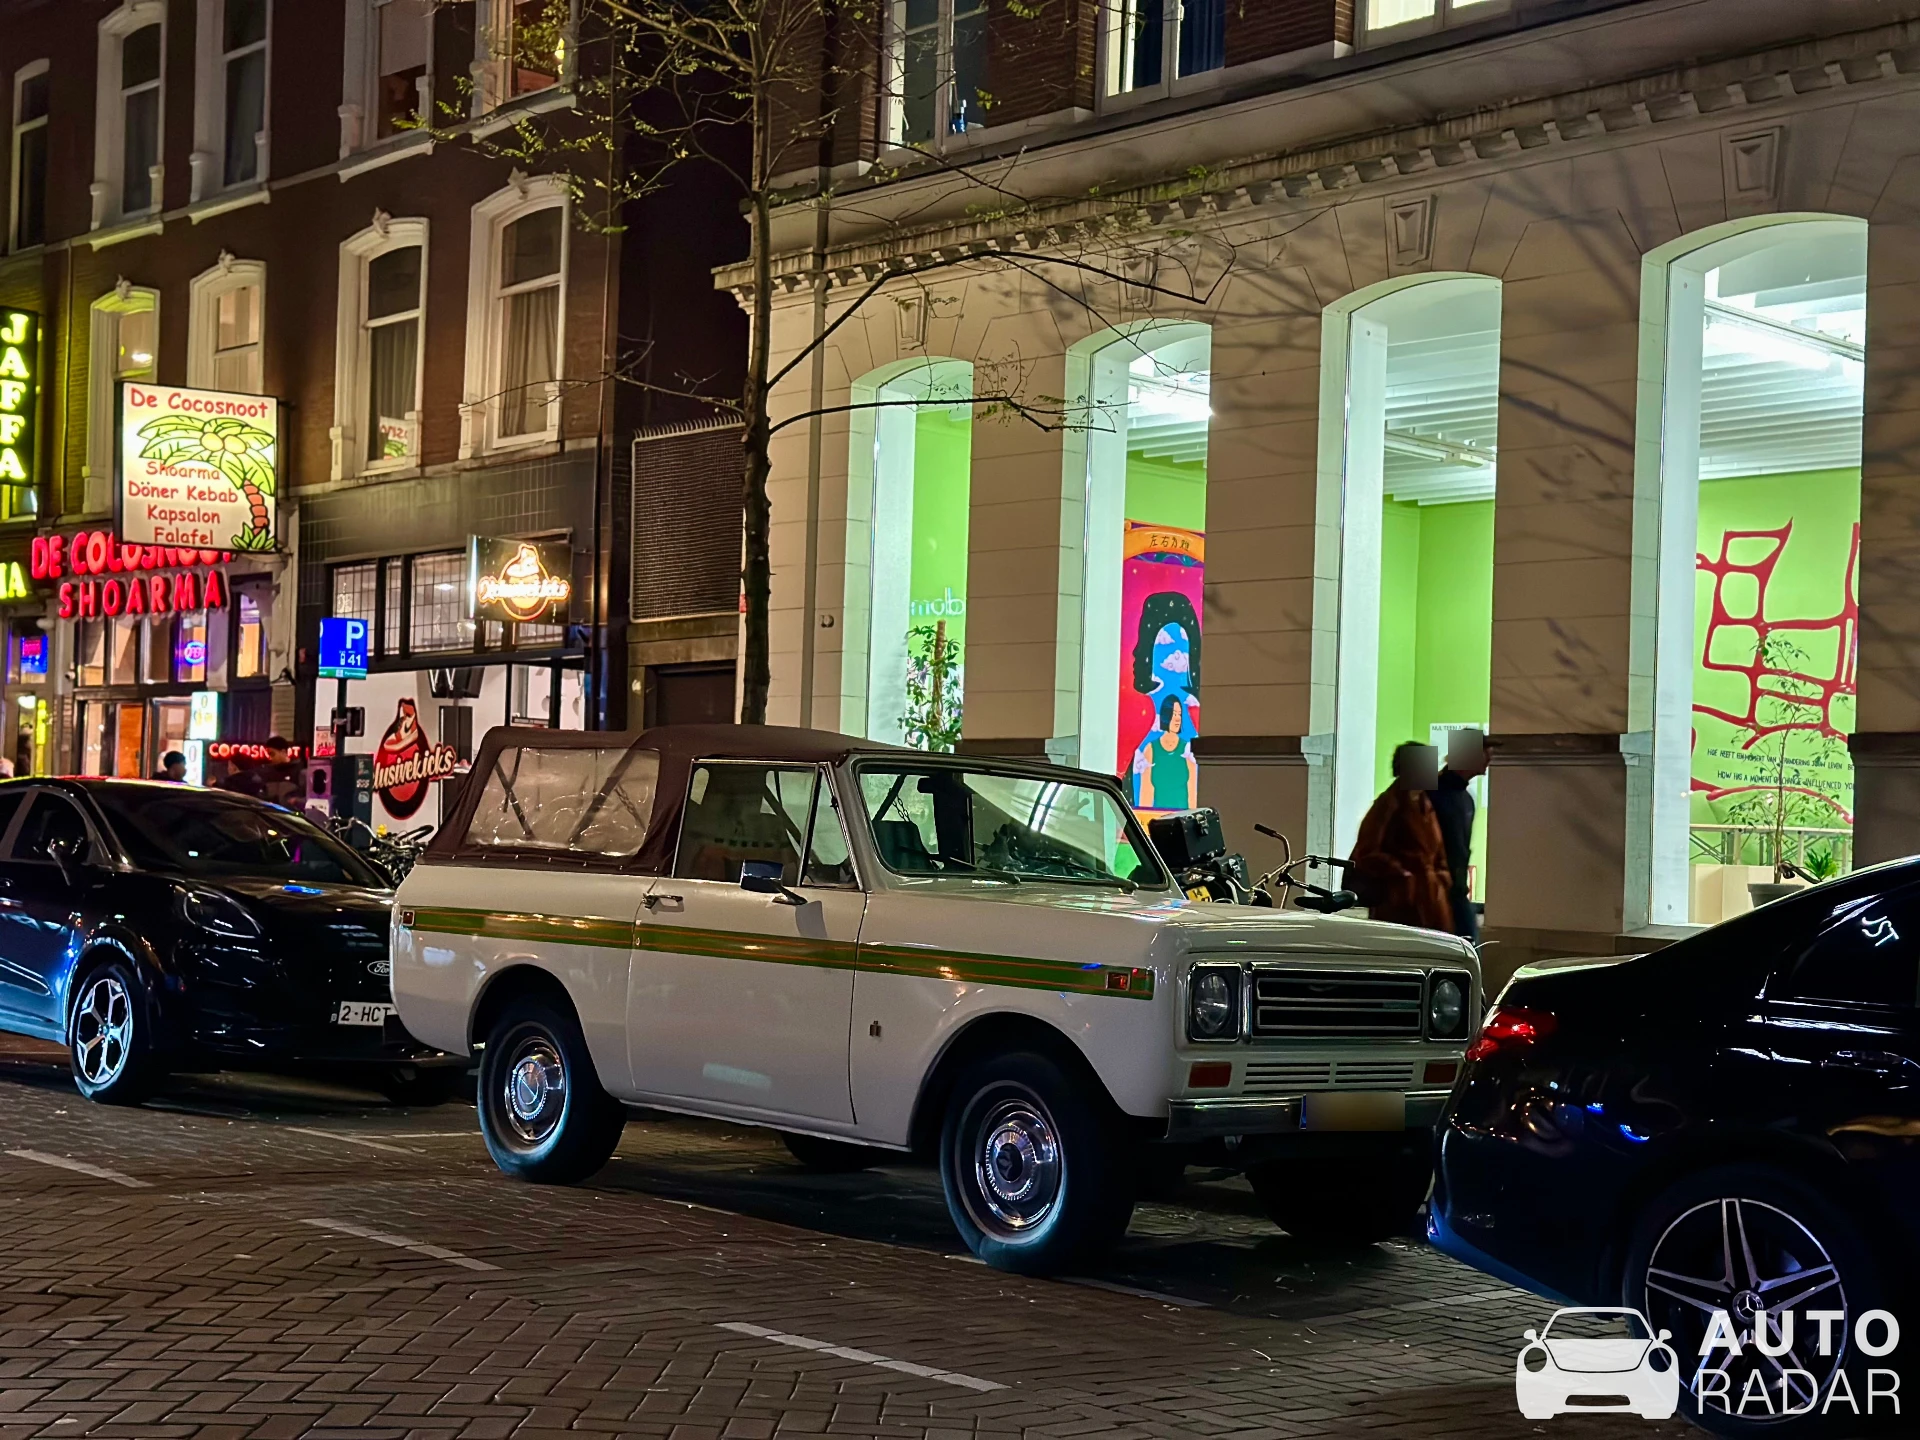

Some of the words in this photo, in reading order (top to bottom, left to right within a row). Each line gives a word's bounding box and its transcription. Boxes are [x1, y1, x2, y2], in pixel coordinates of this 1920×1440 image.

[0, 313, 30, 481] JAFFA
[131, 388, 158, 407] De
[167, 392, 268, 418] Cocosnoot
[146, 461, 220, 480] Shoarma
[128, 481, 179, 499] Döner
[187, 485, 238, 503] Kebab
[147, 504, 220, 525] Kapsalon
[154, 527, 214, 546] Falafel
[31, 535, 63, 580] DE
[58, 569, 222, 618] SHOARMA
[346, 620, 364, 649] P
[347, 653, 361, 666] 41
[1717, 770, 1732, 779] HOW
[1750, 775, 1772, 784] MOMENT
